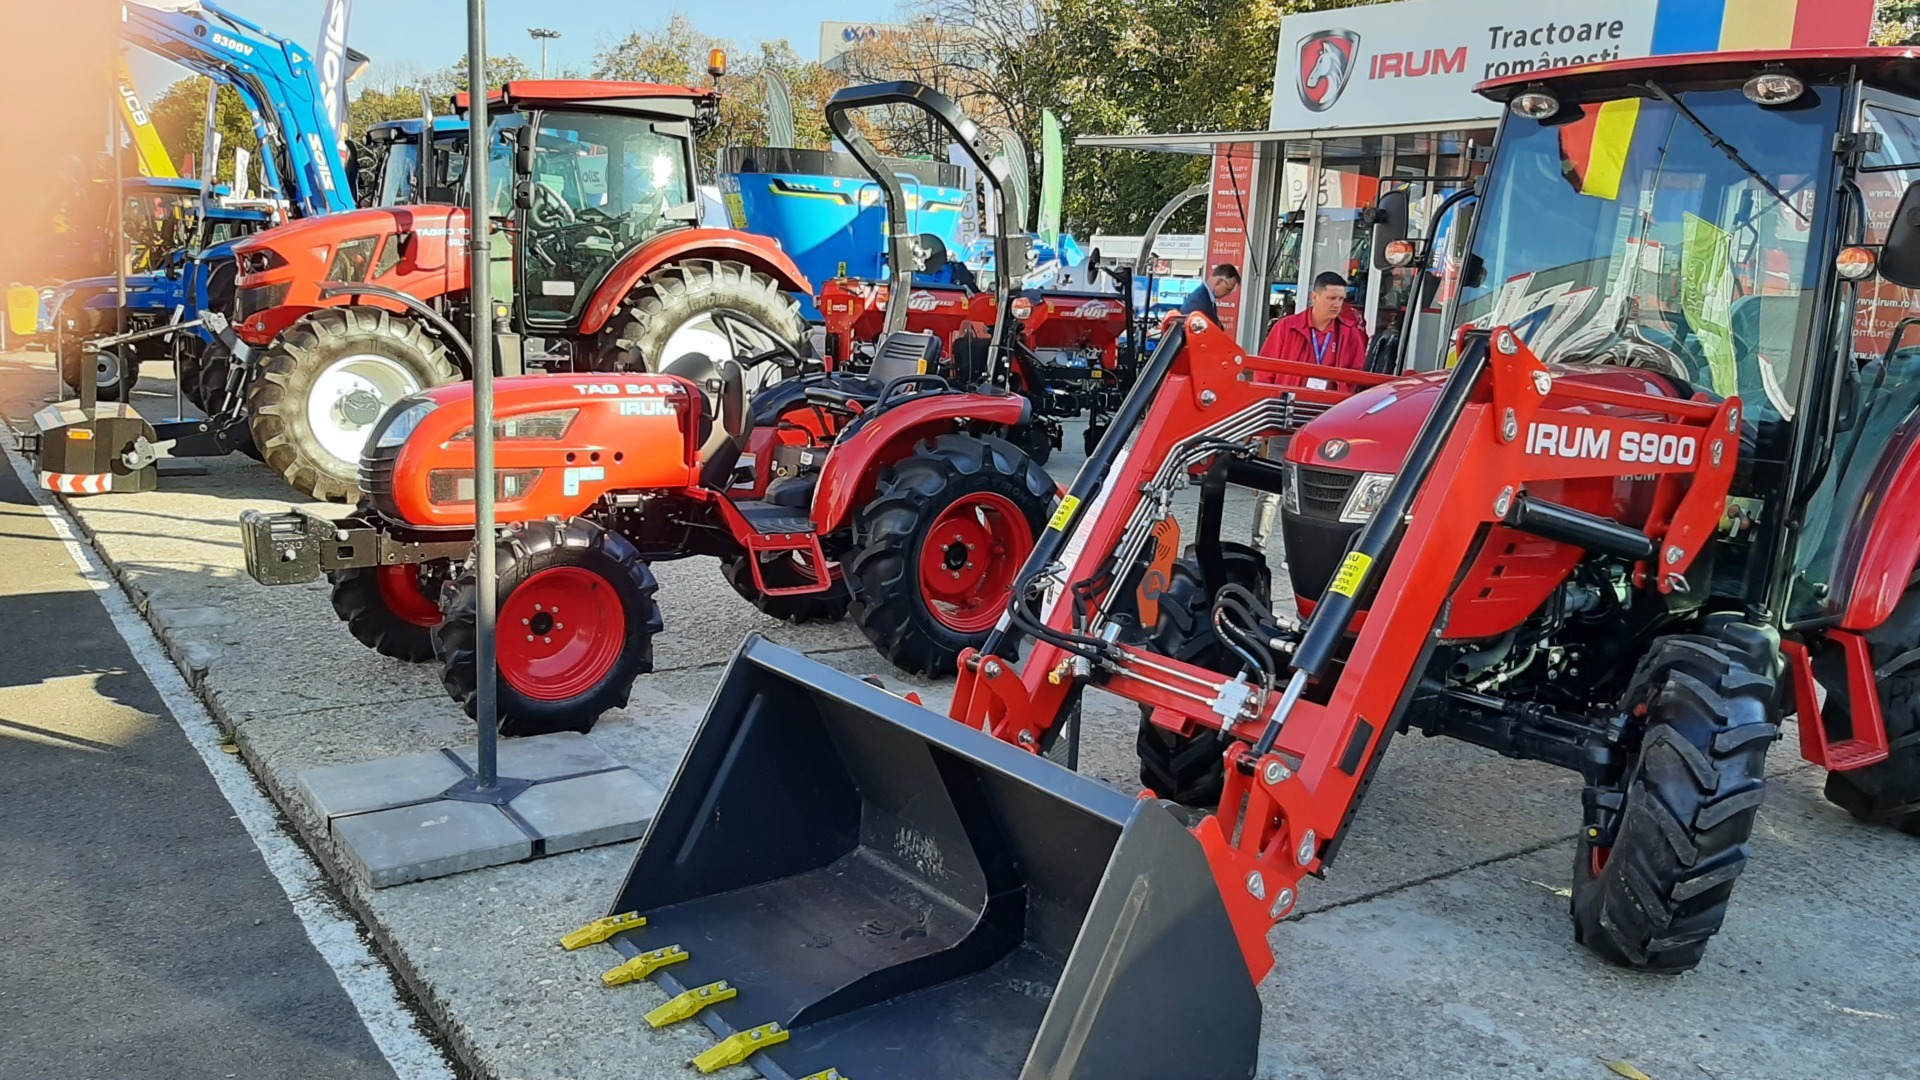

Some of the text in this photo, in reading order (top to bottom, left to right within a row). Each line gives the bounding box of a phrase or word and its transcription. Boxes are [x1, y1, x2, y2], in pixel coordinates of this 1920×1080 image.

[212, 34, 254, 56] 8300V
[1488, 20, 1624, 50] Tractoare
[1368, 46, 1468, 80] IRUM
[119, 84, 149, 127] JCB
[573, 384, 620, 395] TAG
[624, 384, 655, 394] 24
[620, 401, 676, 416] IRUM
[1525, 422, 1696, 466] IRUM S900
